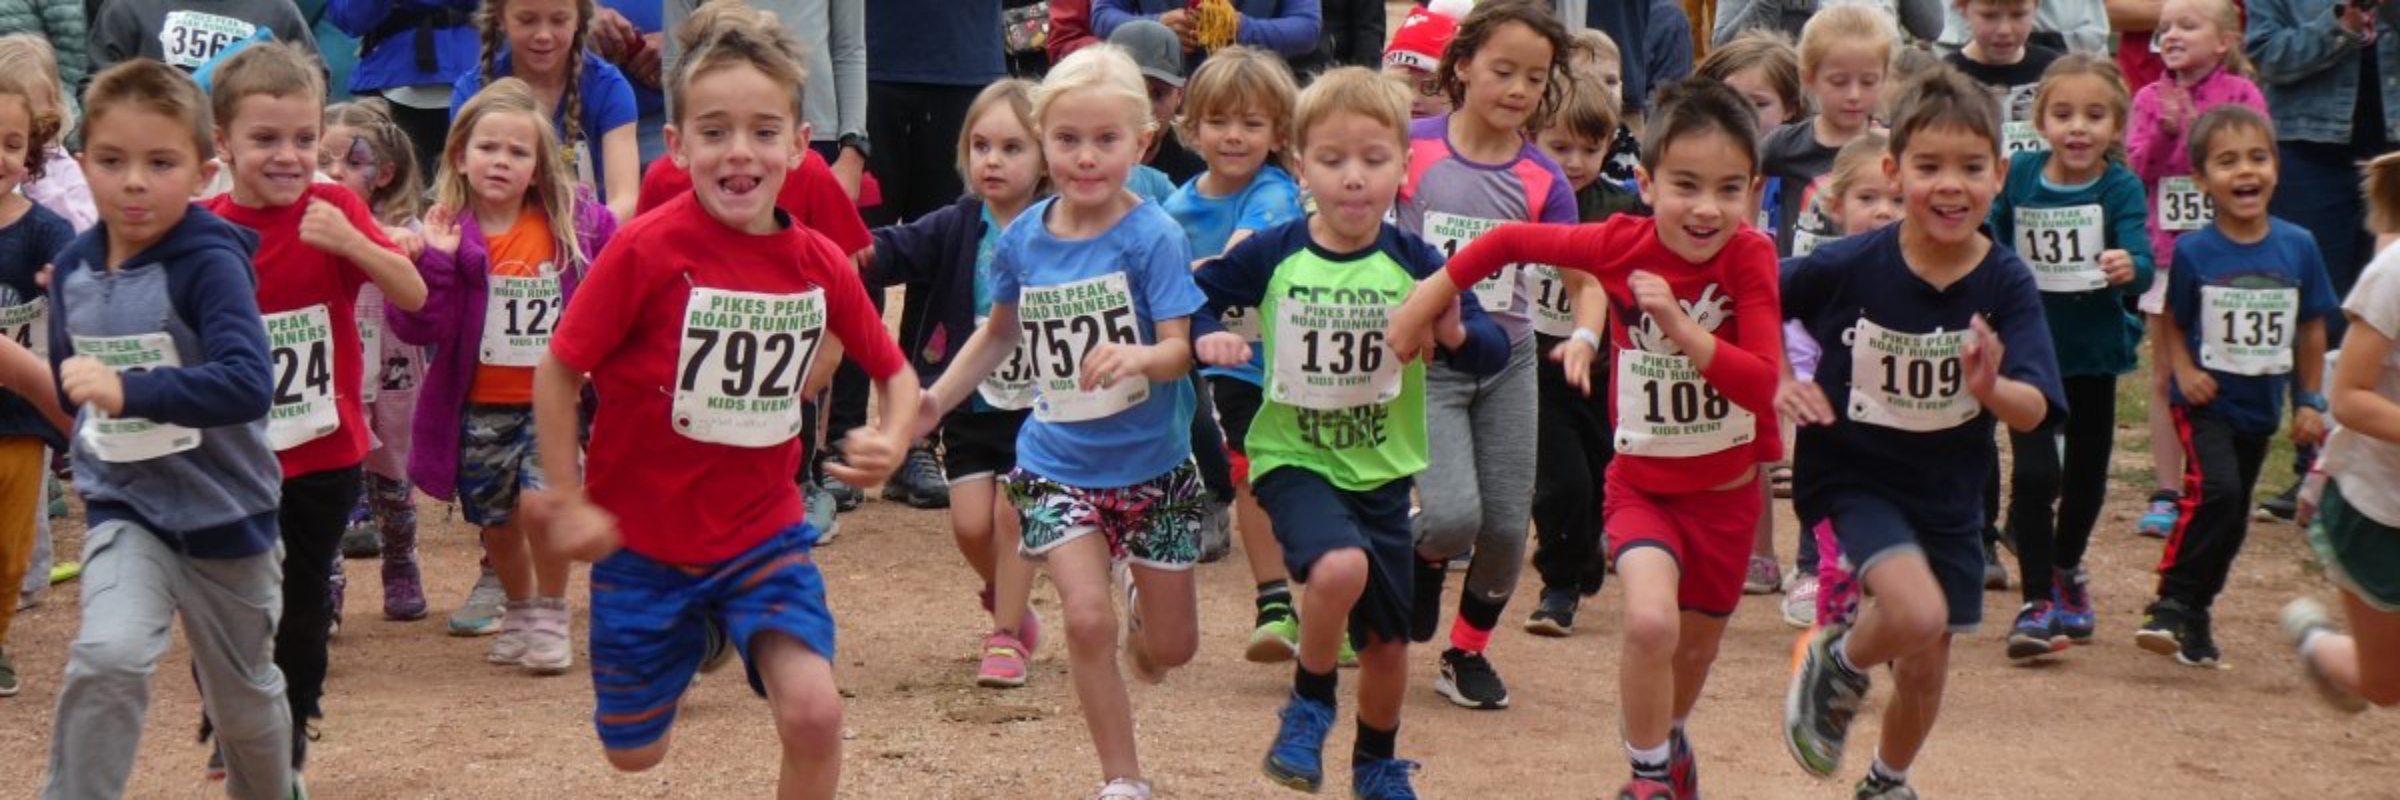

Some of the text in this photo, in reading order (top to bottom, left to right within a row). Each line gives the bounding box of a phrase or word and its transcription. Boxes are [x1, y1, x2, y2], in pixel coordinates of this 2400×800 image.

[171, 26, 243, 58] 356
[2026, 229, 2085, 264] 131
[1025, 281, 1108, 306] PIKES PEAK
[1054, 291, 1127, 318] RUNNERS
[711, 296, 815, 316] PIKES PEAK
[1304, 305, 1385, 319] PIKES PEAK
[268, 313, 310, 333] PEAK
[690, 309, 823, 331] ROAD RUNNERS
[1291, 314, 1326, 328] ROAD
[2223, 311, 2284, 346] 135
[269, 325, 327, 347] NNERS
[1022, 306, 1136, 379] 7525
[1869, 337, 1903, 354] ROAD
[1882, 331, 1962, 347] PIKES PEAK
[680, 327, 821, 397] 7927
[1301, 330, 1384, 374] 136
[1642, 355, 1682, 368] PIKES
[271, 340, 330, 406] 24
[1307, 375, 1372, 386] KIDS EVENT
[1631, 363, 1665, 379] ROAD
[1881, 355, 1962, 398] 109
[271, 402, 312, 419] EVENT
[707, 397, 793, 412] KIDS EVENT
[1643, 379, 1729, 423] 108
[1651, 422, 1721, 435] KIDS EVENT
